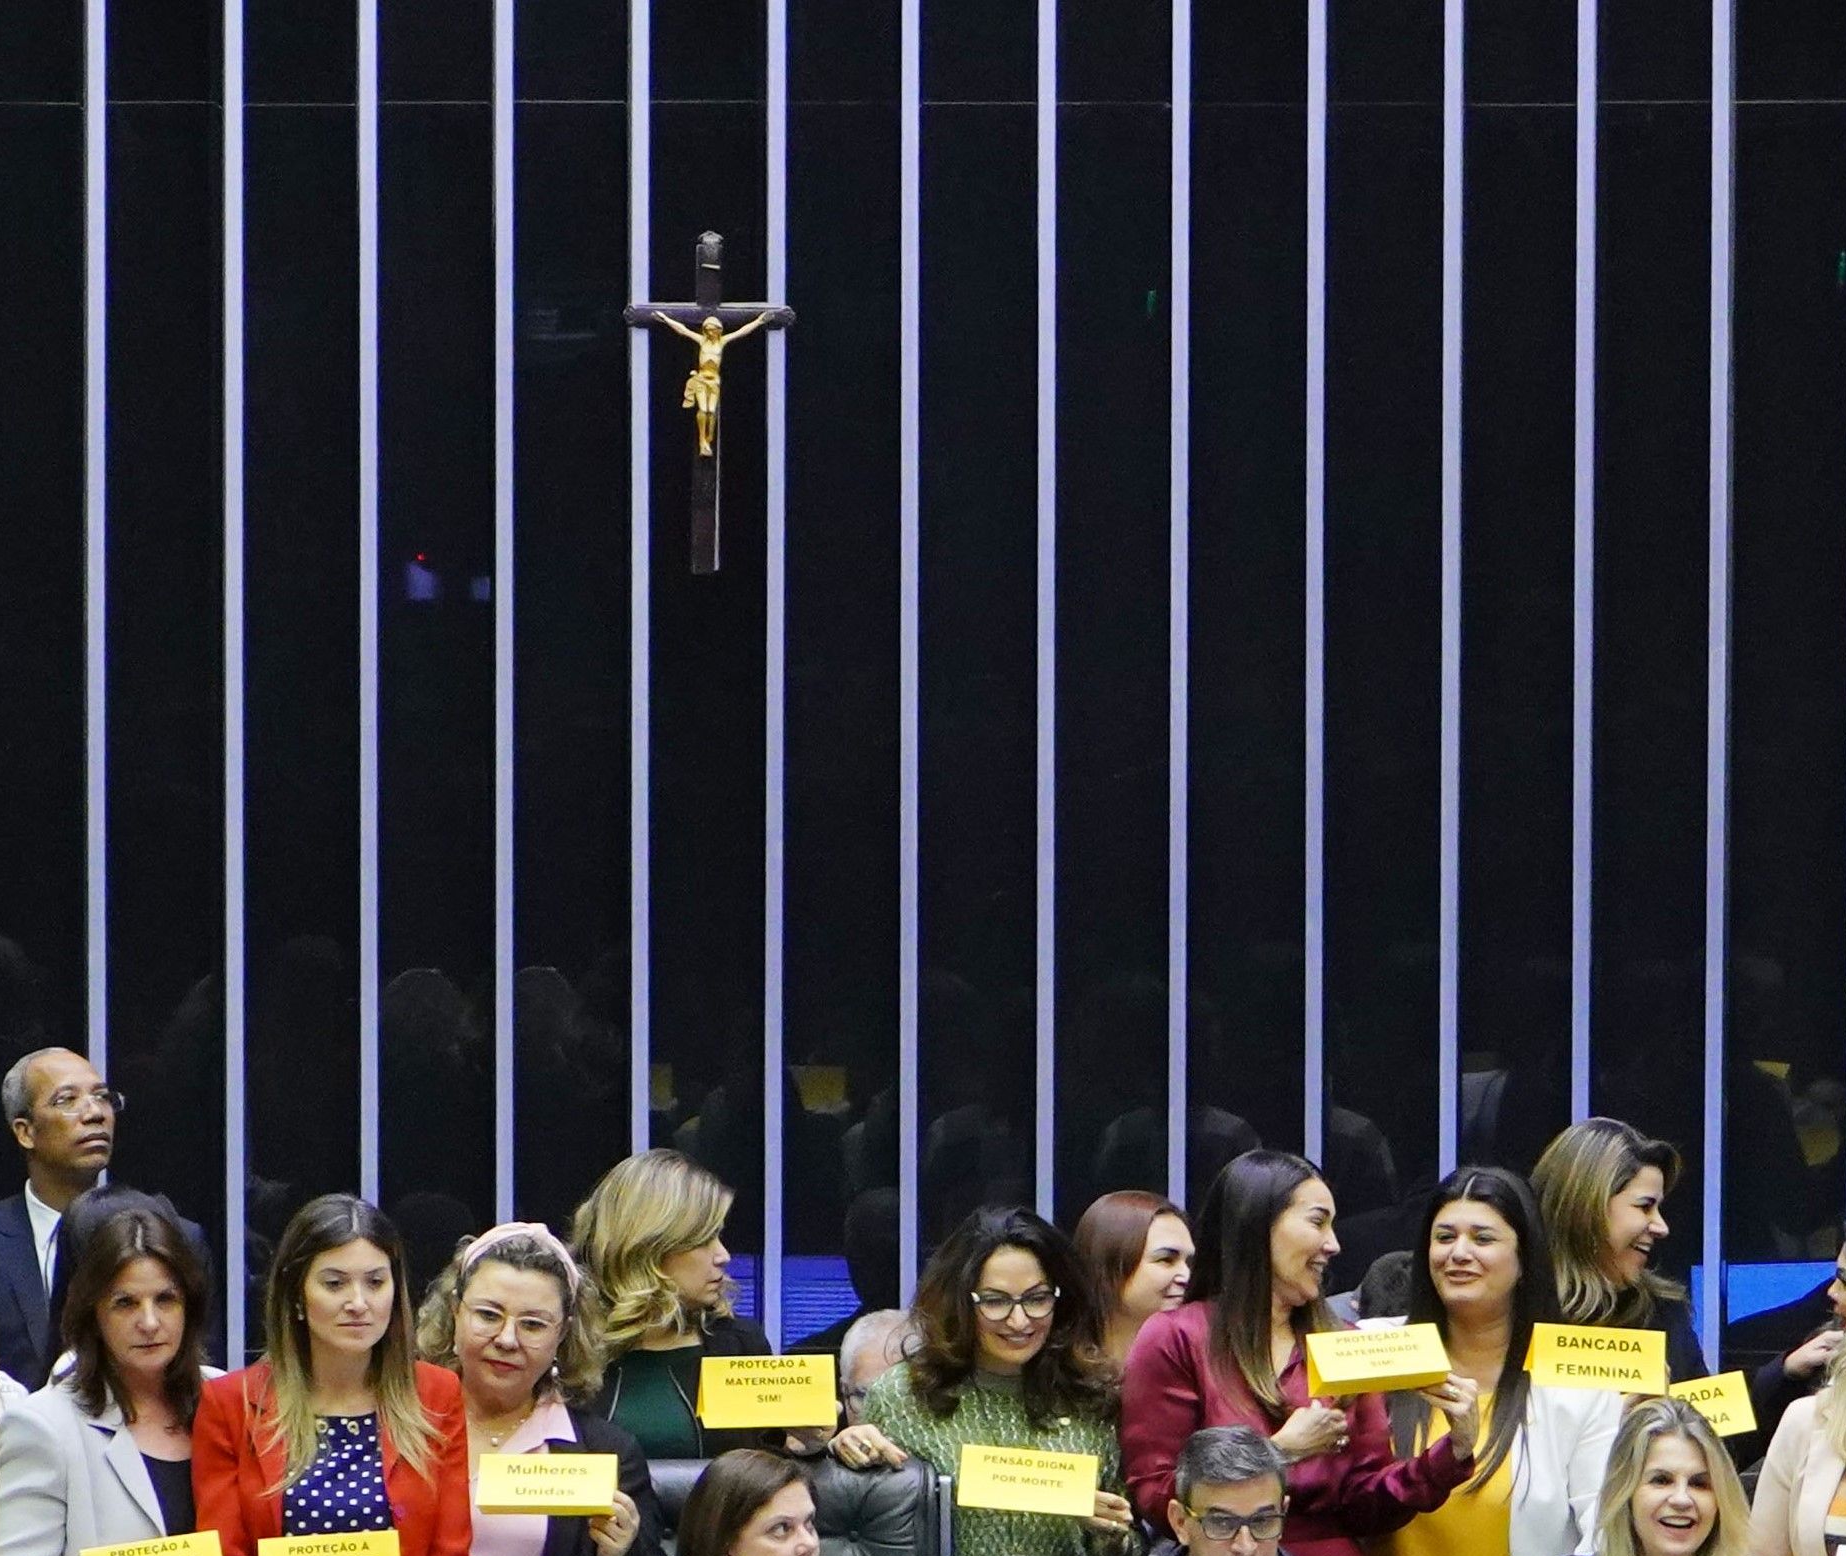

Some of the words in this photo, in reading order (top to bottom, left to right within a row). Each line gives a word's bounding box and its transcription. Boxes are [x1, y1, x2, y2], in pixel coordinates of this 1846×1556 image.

[1556, 1336, 1642, 1353] BANCADA
[730, 1358, 795, 1370] PROTEÇÃO
[1555, 1363, 1643, 1380] FEMININA
[725, 1376, 813, 1386] MATERNIDADE
[757, 1394, 782, 1403] SIM!
[983, 1454, 1033, 1467] PENSÃO
[1036, 1460, 1076, 1471] DIGNA
[507, 1464, 588, 1475] Mulheres
[992, 1474, 1016, 1483] POR
[1021, 1477, 1064, 1488] MORTE
[515, 1486, 575, 1496] Unidas
[288, 1542, 357, 1555] PROTEÇÃO
